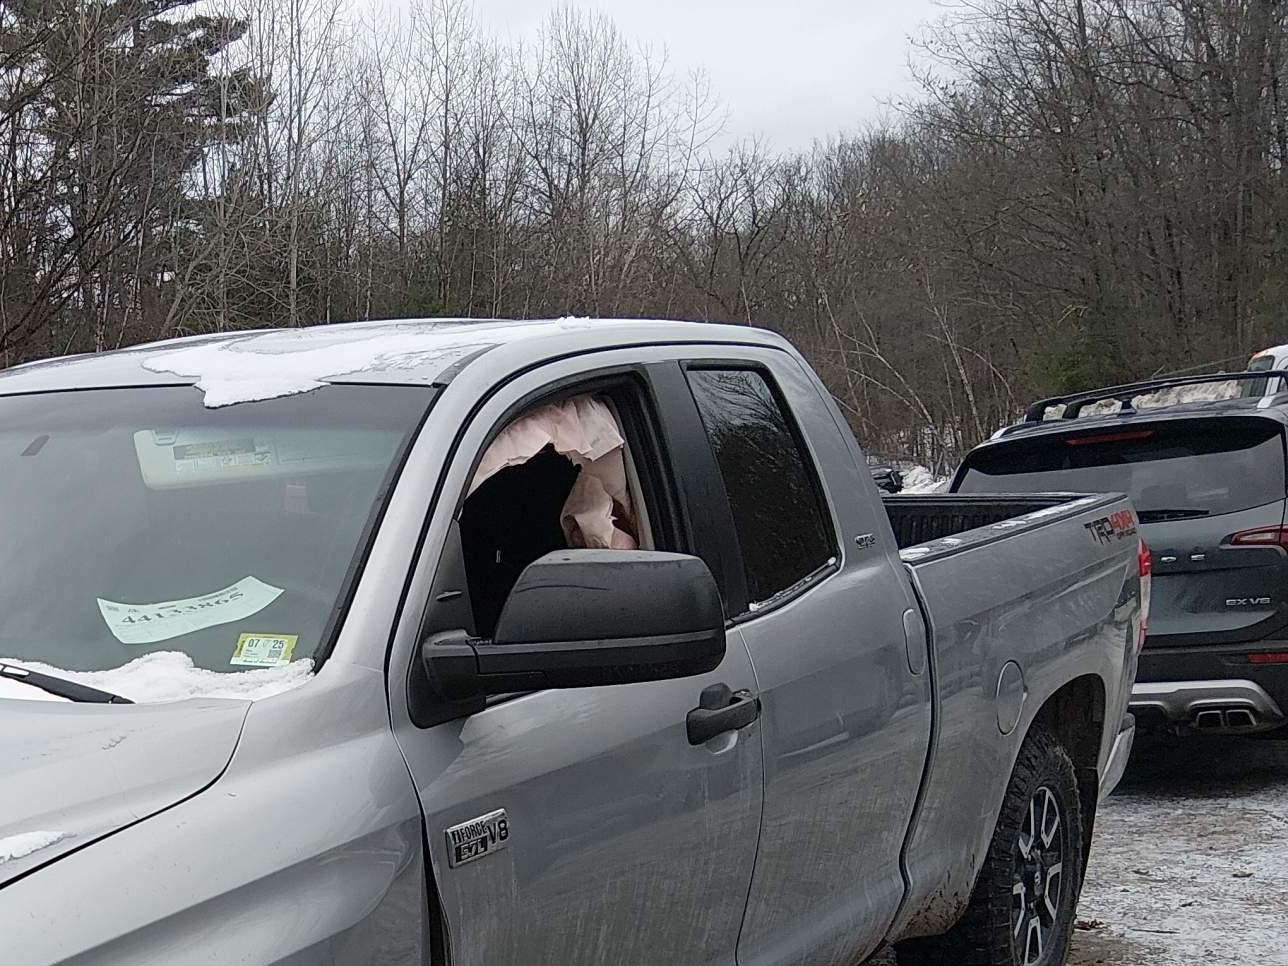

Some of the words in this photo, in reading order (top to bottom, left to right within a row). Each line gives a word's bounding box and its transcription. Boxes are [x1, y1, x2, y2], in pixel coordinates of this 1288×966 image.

[248, 639, 260, 648] 07
[272, 639, 285, 649] 25
[487, 819, 509, 844] V8
